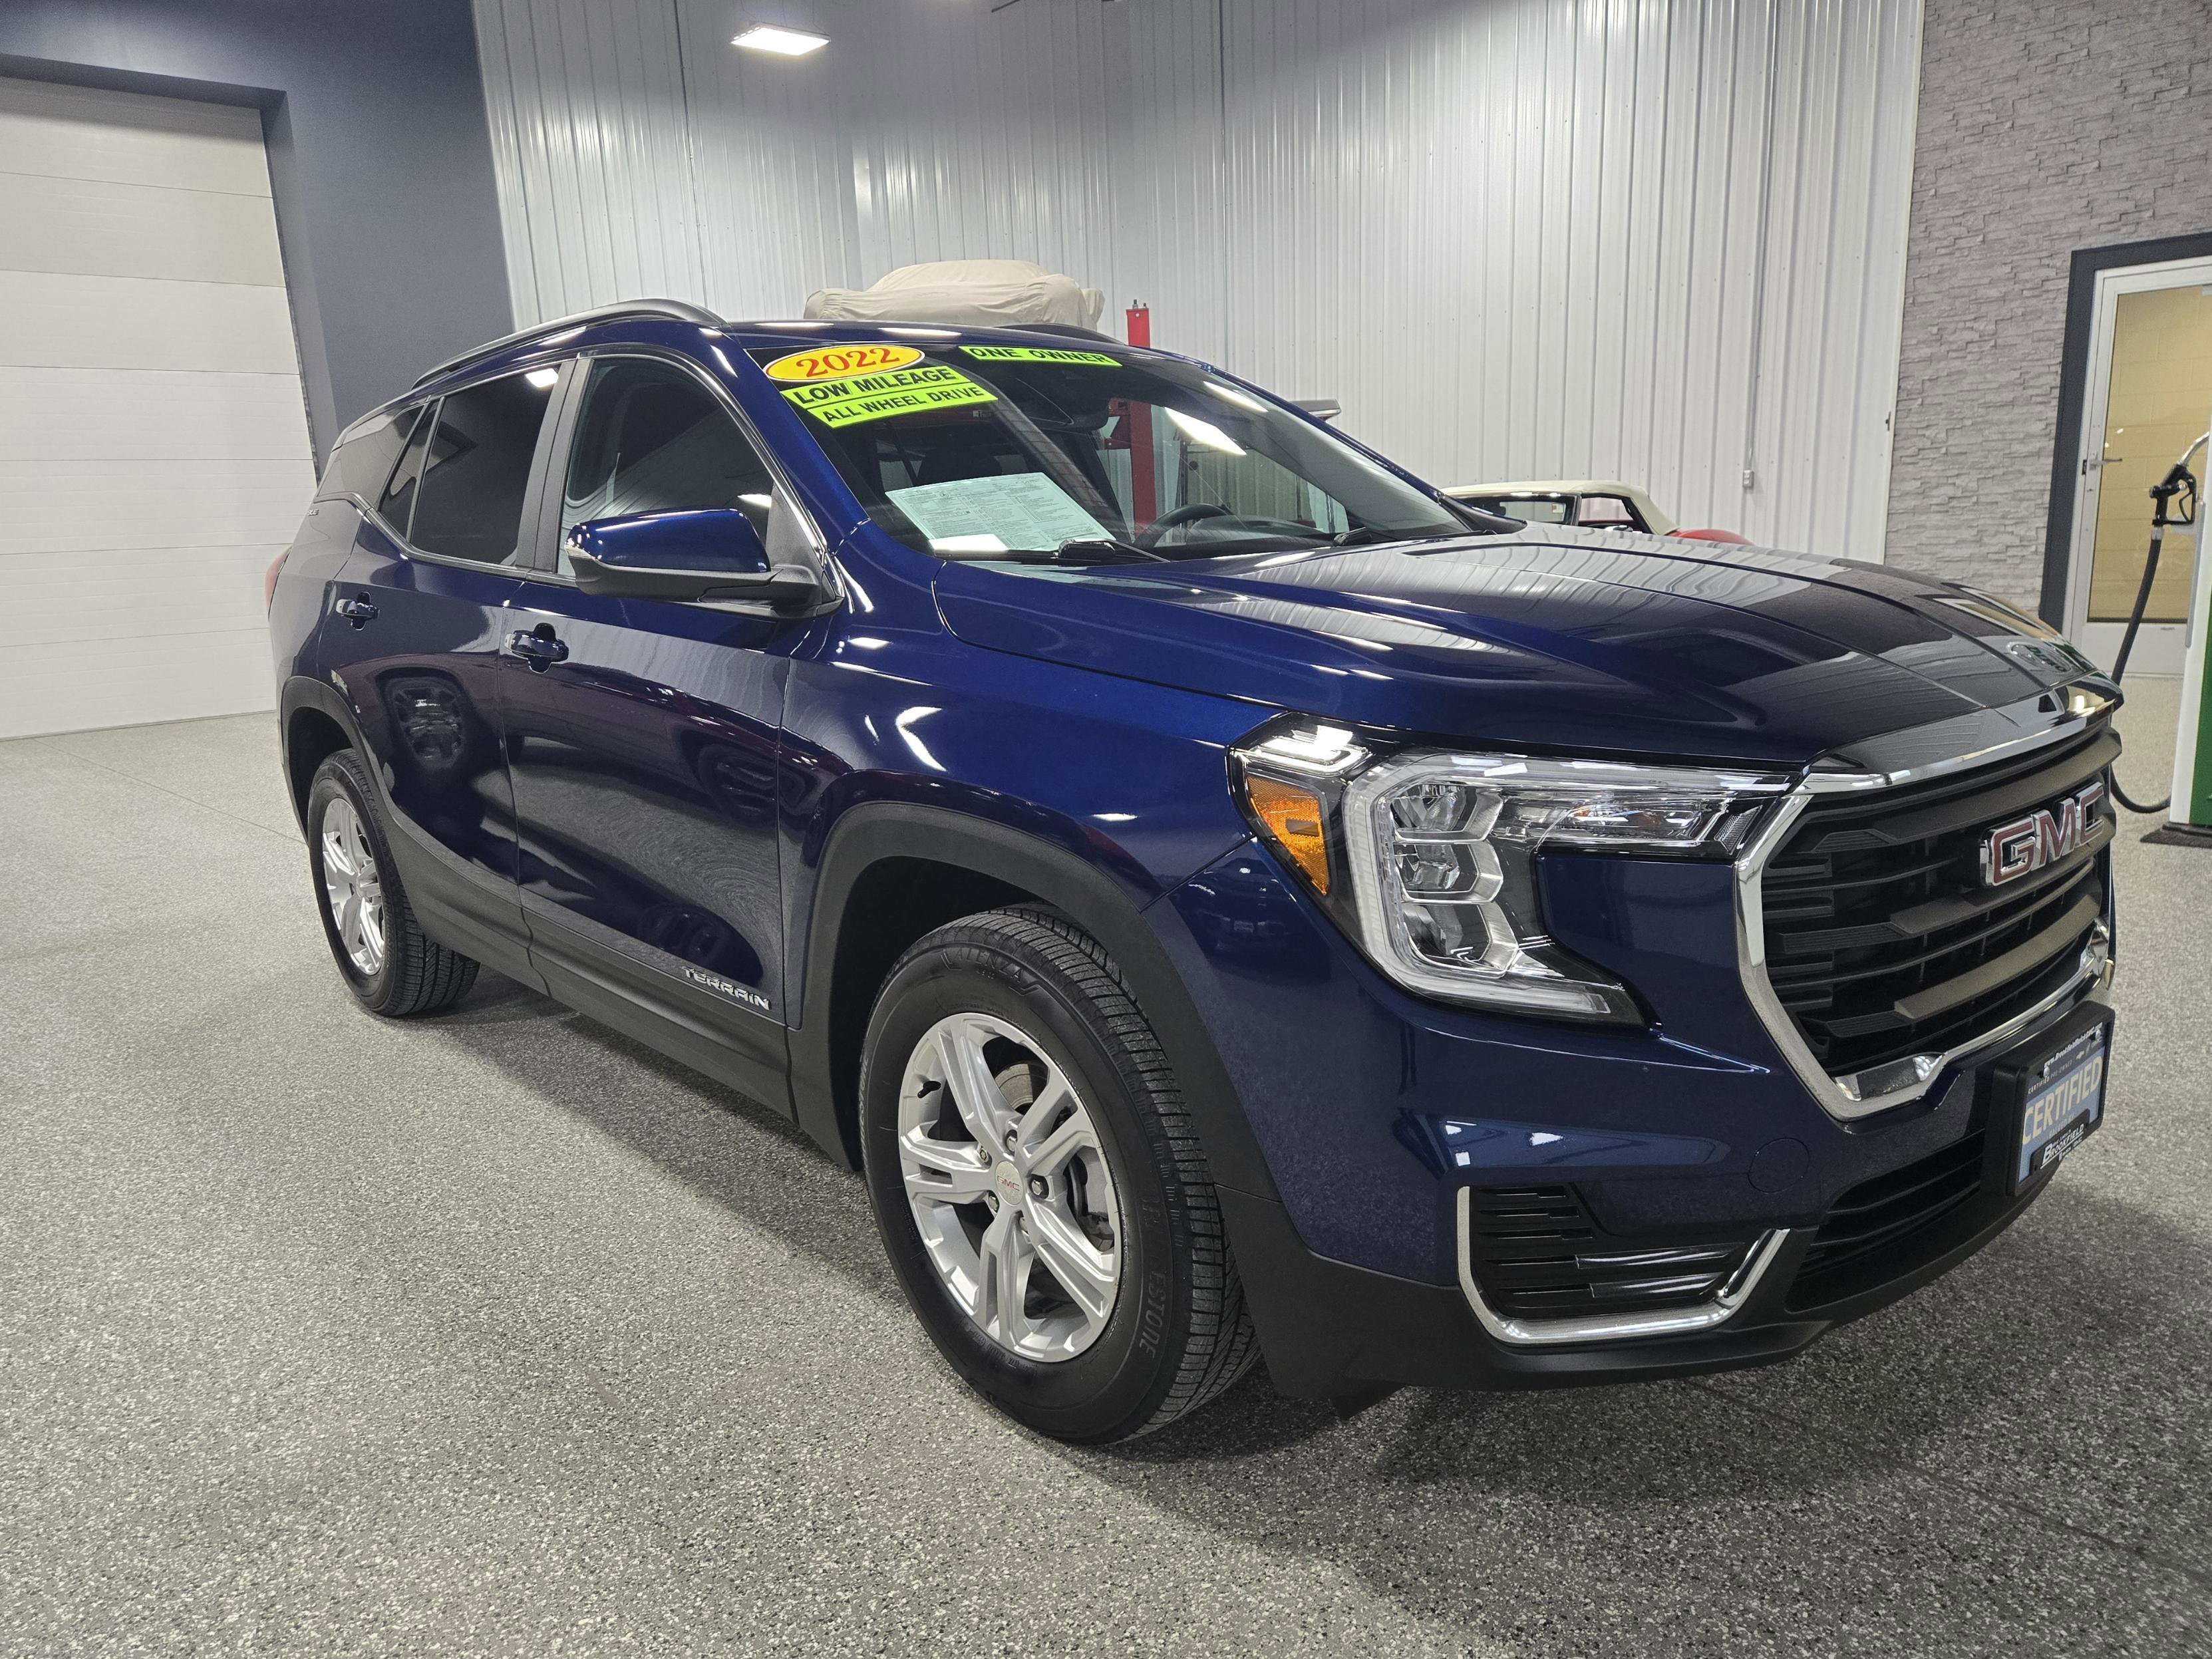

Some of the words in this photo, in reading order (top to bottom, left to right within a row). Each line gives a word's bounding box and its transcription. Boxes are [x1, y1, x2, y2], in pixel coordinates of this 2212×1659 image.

[796, 348, 900, 377] 2022
[970, 347, 1021, 359] ONE
[1030, 349, 1108, 363] OWNER
[794, 382, 851, 404] LOW
[854, 368, 957, 392] MILEAGE
[822, 405, 861, 422] ALL
[858, 394, 927, 414] WHEEL
[927, 386, 985, 402] DRIVE
[1985, 782, 2105, 886] GMC
[681, 966, 771, 1011] TERRAIN
[2022, 1056, 2103, 1144] CERTIFIED
[2042, 1124, 2084, 1165] BROOKFIELD
[997, 1175, 1021, 1191] GMC
